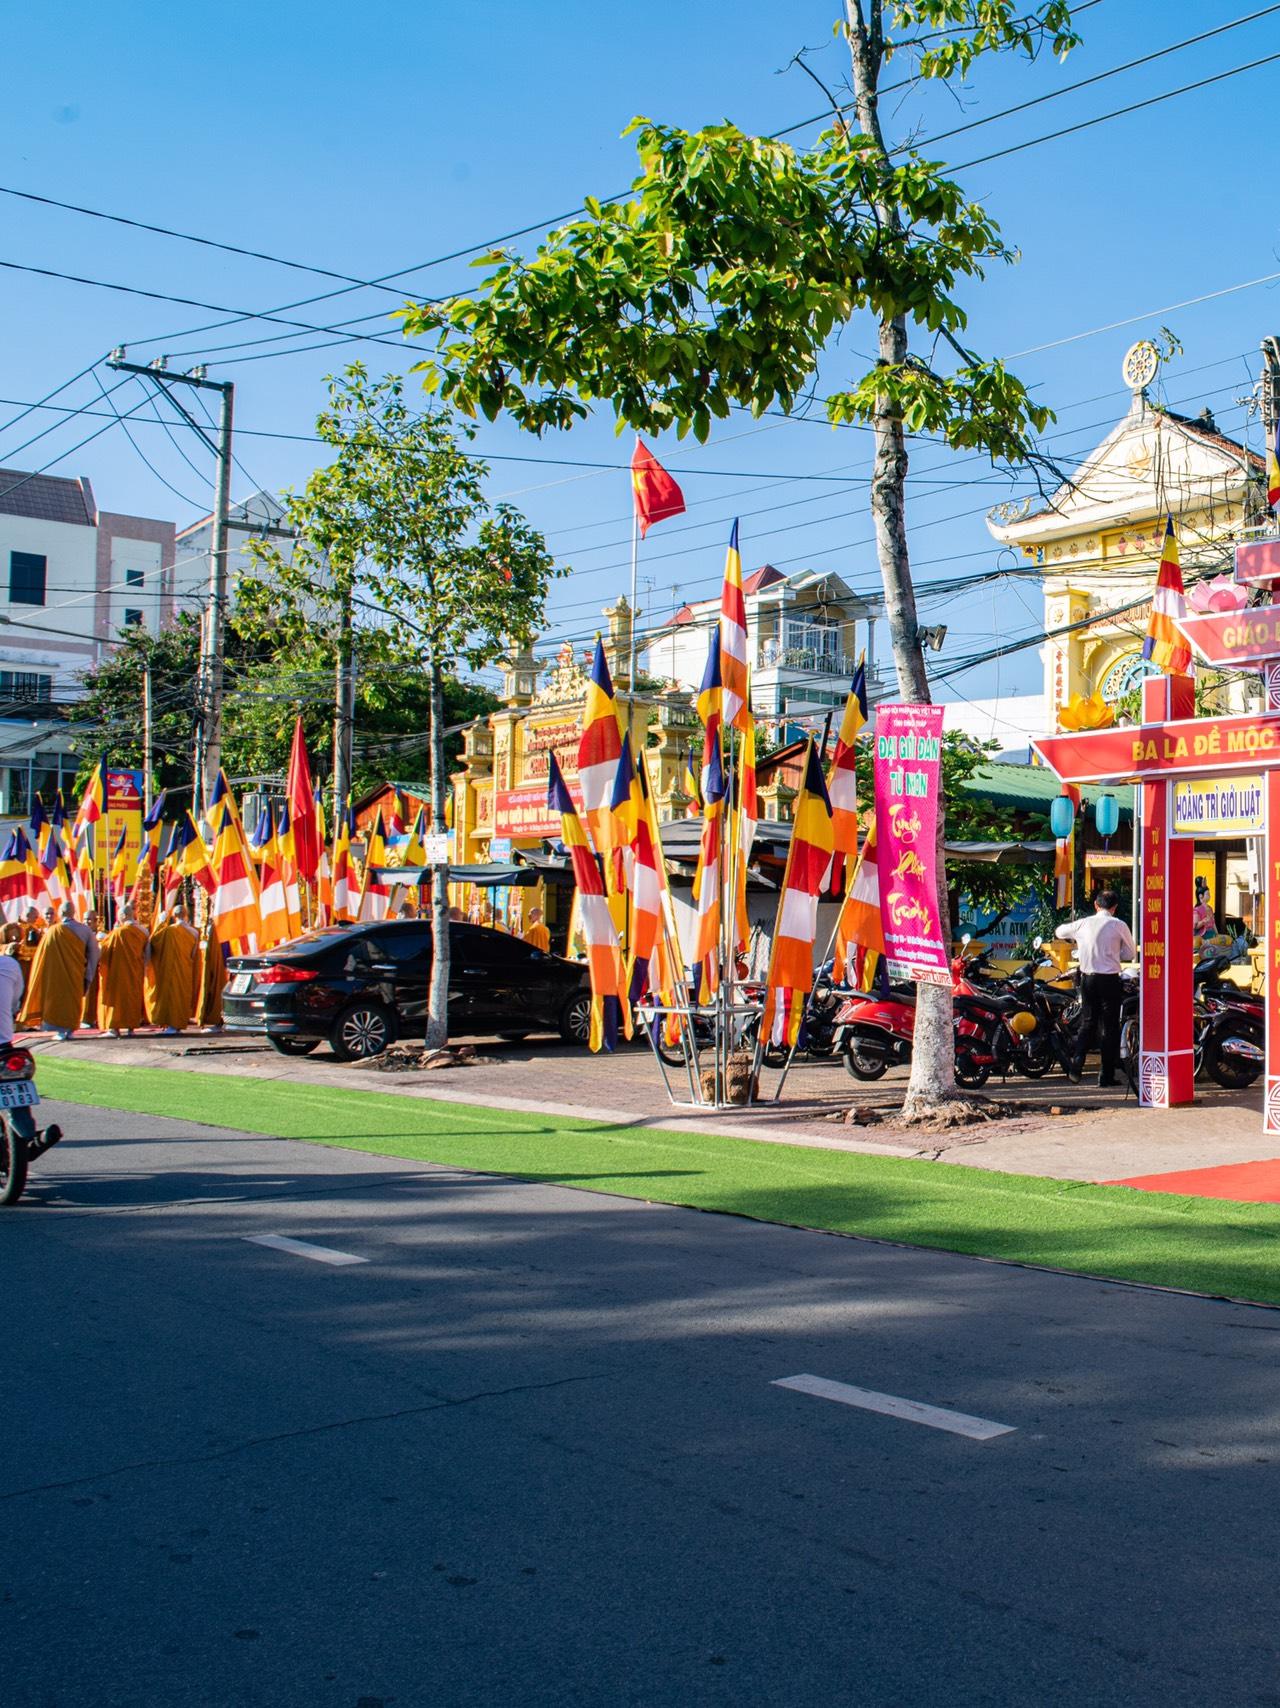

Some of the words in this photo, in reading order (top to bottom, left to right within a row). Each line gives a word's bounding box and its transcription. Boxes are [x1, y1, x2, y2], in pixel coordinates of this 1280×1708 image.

[1223, 621, 1269, 649] GIÁO
[1132, 740, 1158, 762] BA
[1164, 737, 1189, 760] LA
[1193, 725, 1221, 757] ĐỀ
[1227, 726, 1275, 757] MỘC
[1206, 785, 1219, 819] TRÌ
[1221, 784, 1238, 818] GIỚI
[1240, 784, 1261, 824] LUẬT
[1009, 921, 1028, 936] ATM
